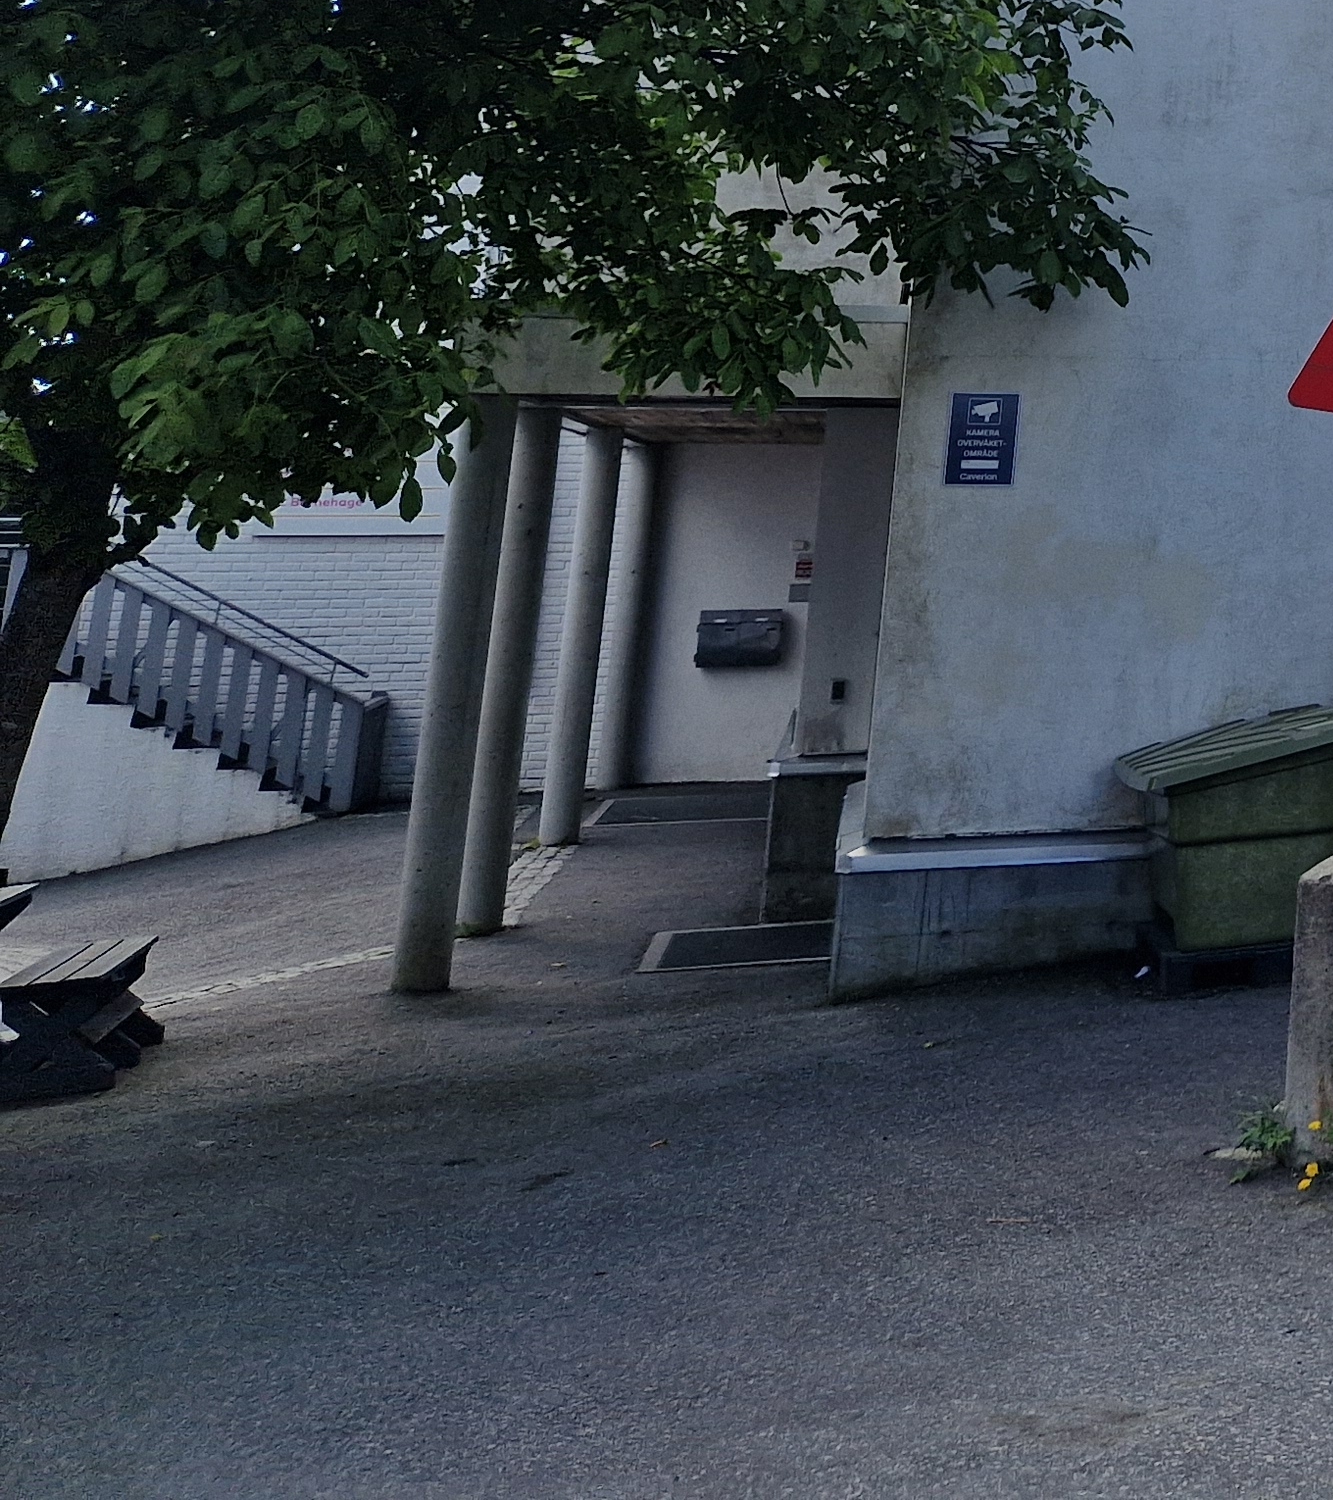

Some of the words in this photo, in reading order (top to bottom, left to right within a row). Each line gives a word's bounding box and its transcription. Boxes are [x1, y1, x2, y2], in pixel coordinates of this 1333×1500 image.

[966, 428, 1000, 437] KAMERA
[963, 448, 999, 458] OMRÅDE
[959, 472, 998, 481] Caverion
[290, 497, 363, 509] Bnehage
